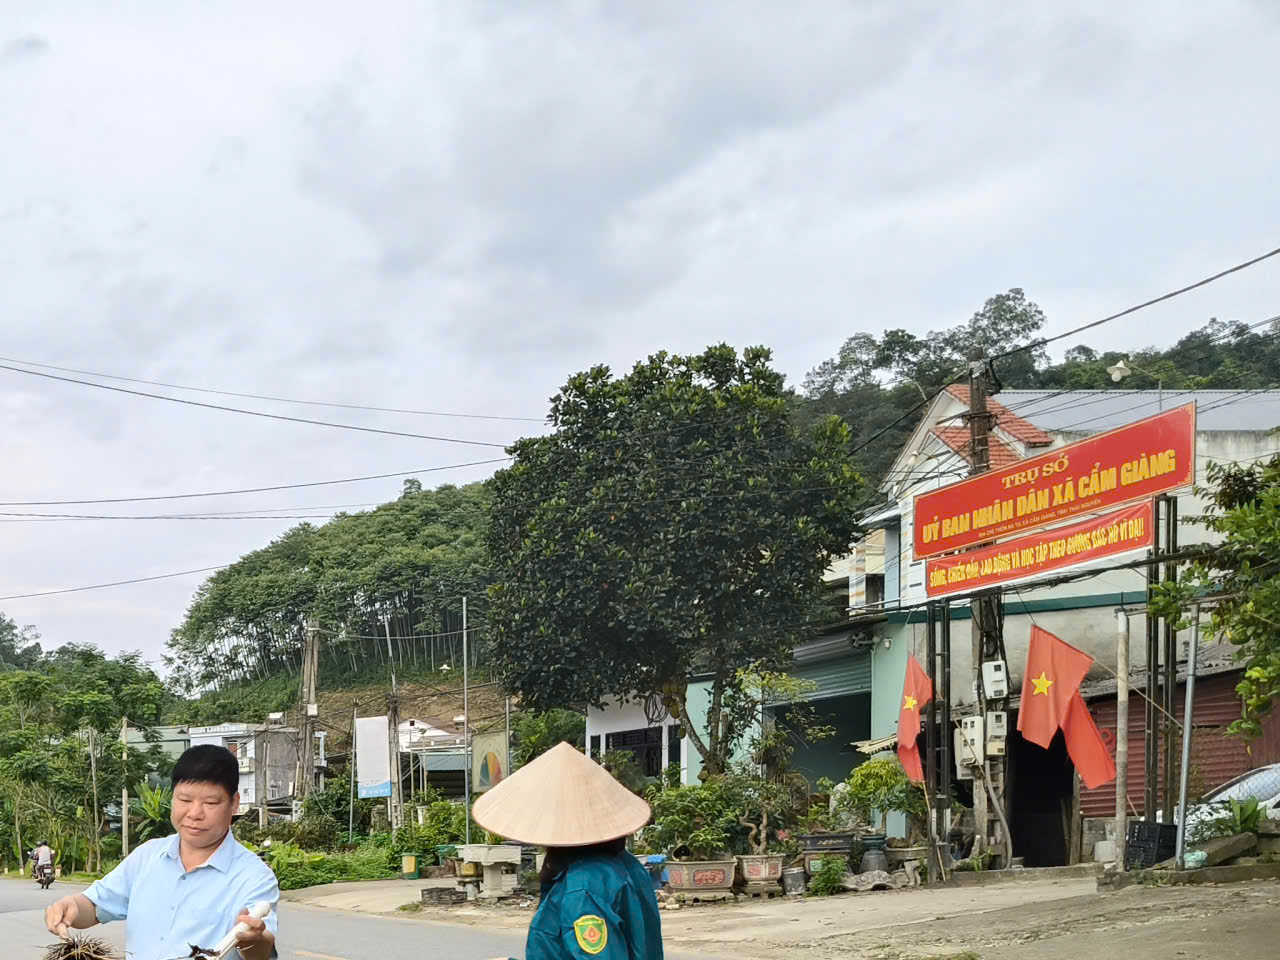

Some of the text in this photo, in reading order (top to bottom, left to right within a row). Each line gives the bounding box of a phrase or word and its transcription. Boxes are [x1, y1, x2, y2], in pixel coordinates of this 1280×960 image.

[1001, 452, 1070, 489] TRỤ SỞ
[941, 512, 970, 539] BAN
[972, 499, 1014, 530] NHÂN
[1016, 488, 1049, 518] DÂN
[1052, 476, 1076, 507] XÃ
[1078, 462, 1117, 498] CẨM
[1120, 450, 1176, 486] GIÀNG
[1049, 538, 1067, 561] THEO
